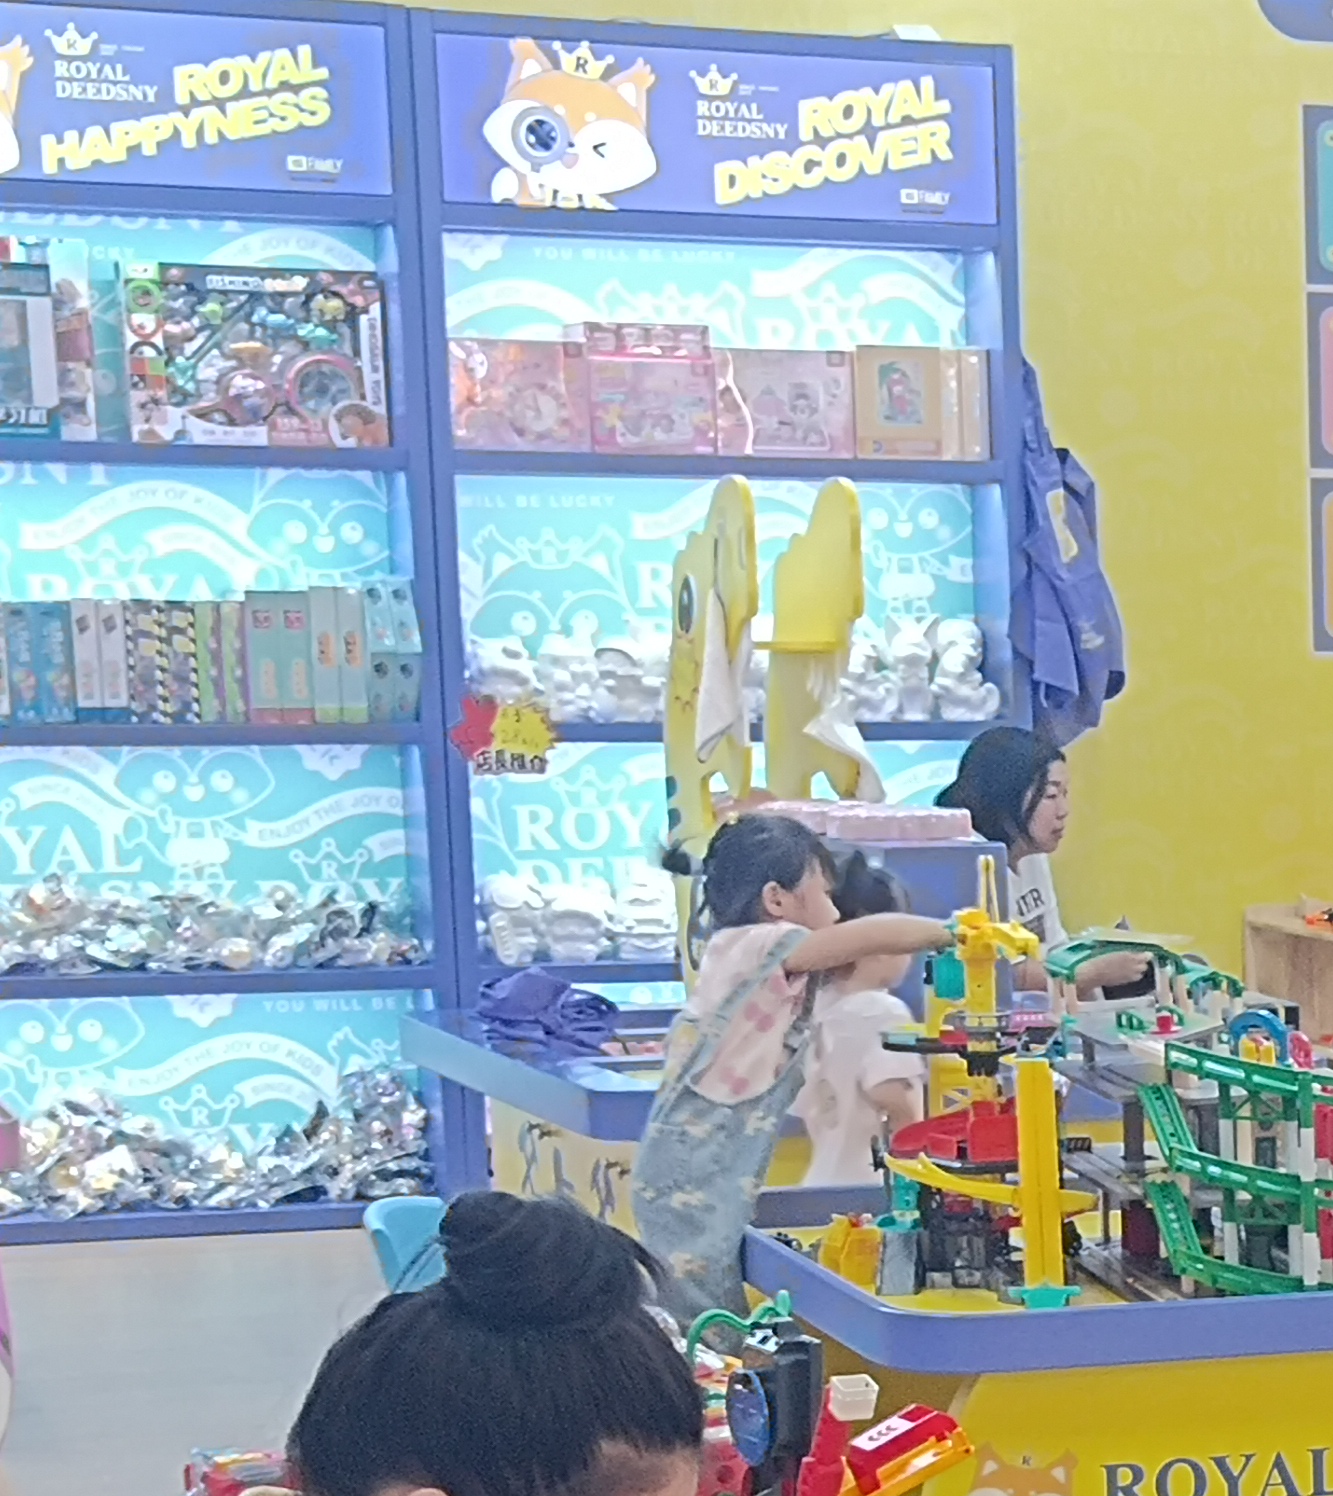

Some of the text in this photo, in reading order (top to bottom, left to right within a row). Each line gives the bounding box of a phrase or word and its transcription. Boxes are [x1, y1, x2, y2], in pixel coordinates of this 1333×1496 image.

[54, 59, 131, 82] ROYAL
[173, 44, 331, 105] ROYAL
[573, 56, 589, 75] R
[55, 81, 158, 103] DEEDSNY
[697, 100, 764, 121] ROYAL
[798, 75, 952, 142] ROYAL
[40, 86, 332, 176] HAPPYNESS
[697, 119, 788, 141] DEEDSNY
[713, 120, 953, 207] DISCOVER
[549, 494, 616, 508] LUCKY
[321, 860, 340, 880] R
[263, 999, 305, 1013] YOU
[313, 998, 362, 1012] WILL
[372, 998, 396, 1011] BE
[128, 1065, 180, 1088] ENJOY
[222, 1040, 253, 1054] JOY
[259, 1040, 281, 1053] OF
[285, 1047, 325, 1077] KIDS
[192, 1106, 210, 1126] R
